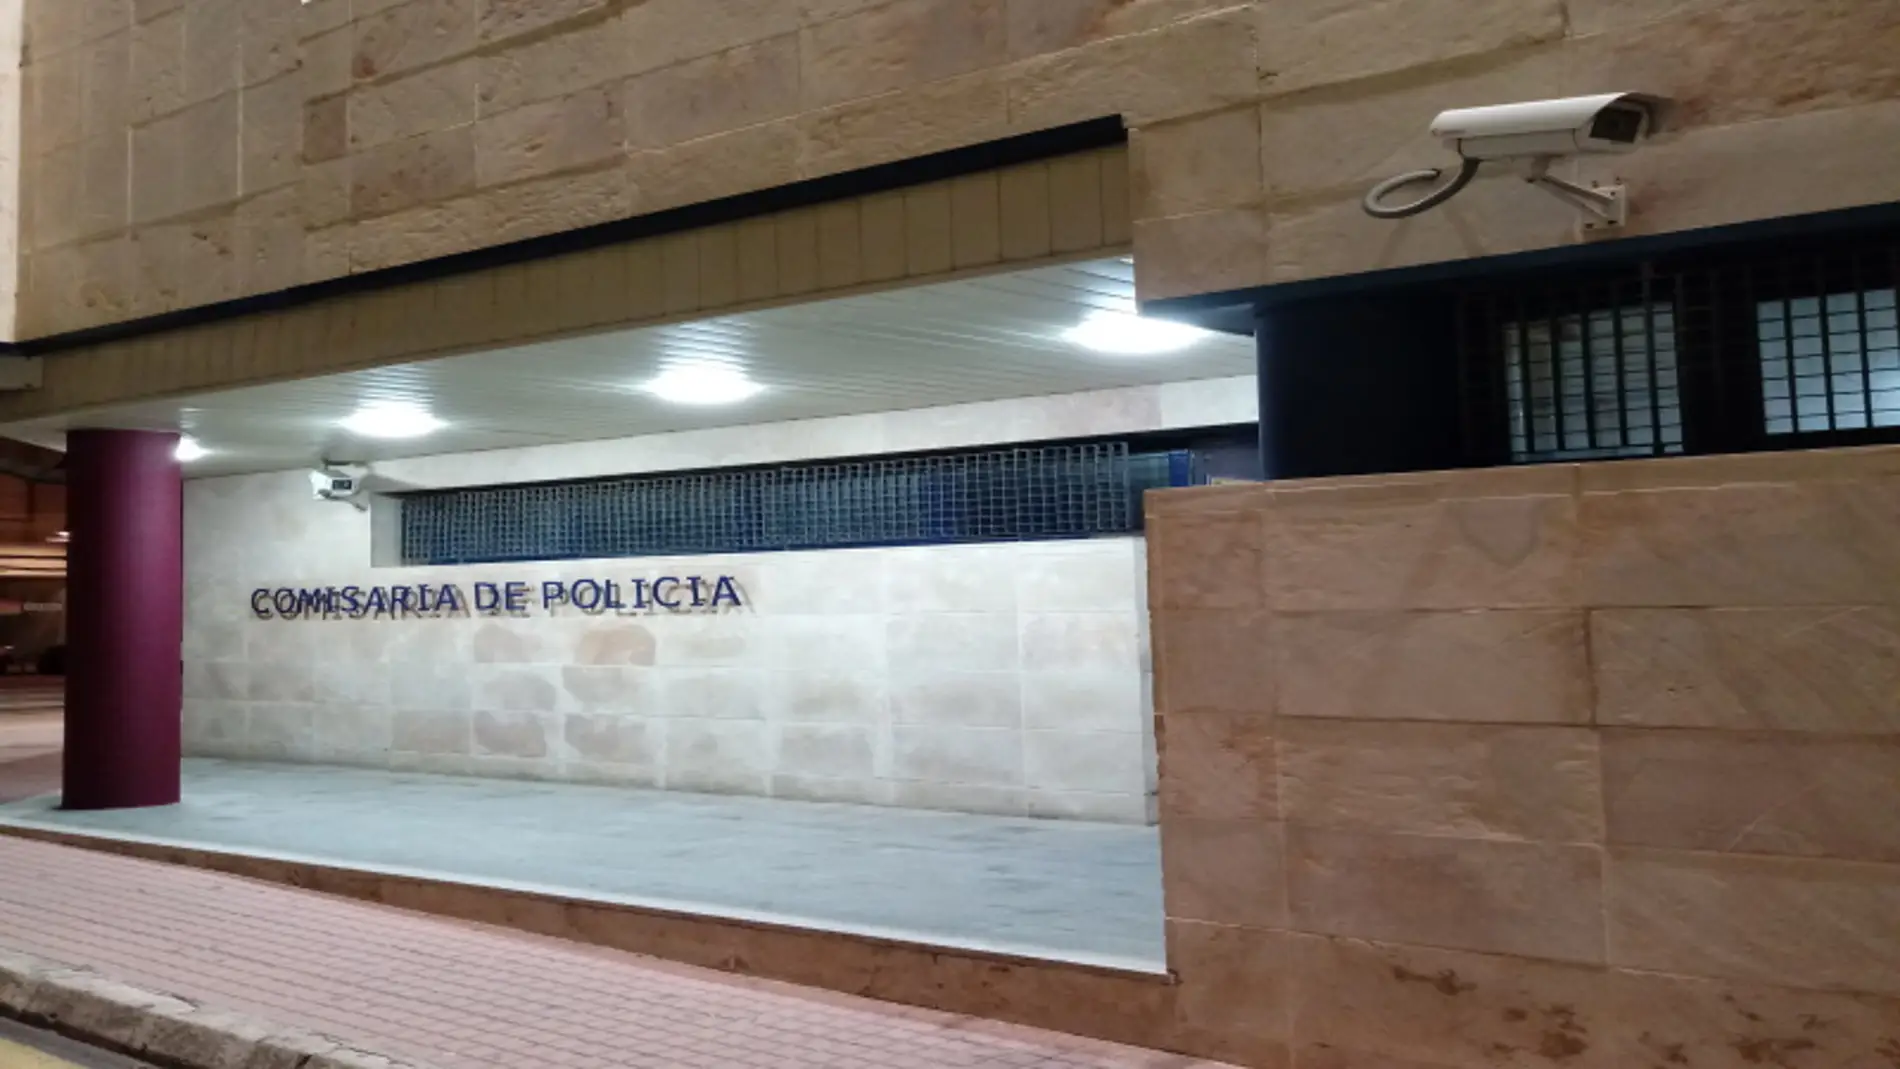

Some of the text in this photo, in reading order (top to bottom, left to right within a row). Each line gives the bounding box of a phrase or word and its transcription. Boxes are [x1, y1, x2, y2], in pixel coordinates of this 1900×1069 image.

[250, 575, 743, 615] COMISARIA DE POLICIA
